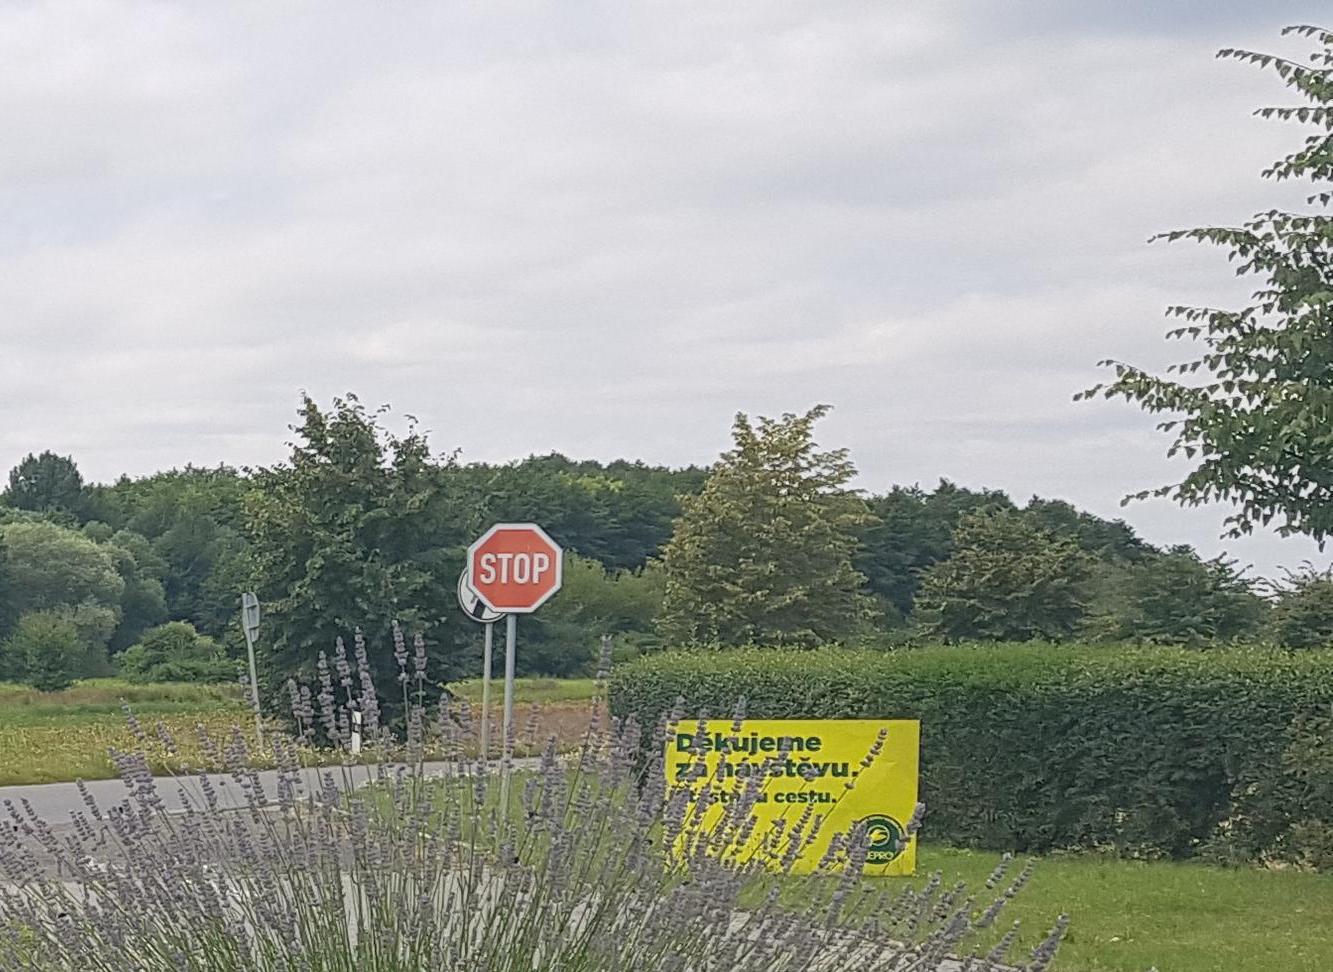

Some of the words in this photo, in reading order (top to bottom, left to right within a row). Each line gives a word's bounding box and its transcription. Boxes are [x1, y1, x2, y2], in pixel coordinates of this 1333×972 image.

[480, 552, 549, 585] STOP
[774, 790, 837, 803] cestu.
[867, 851, 894, 860] EPRO
